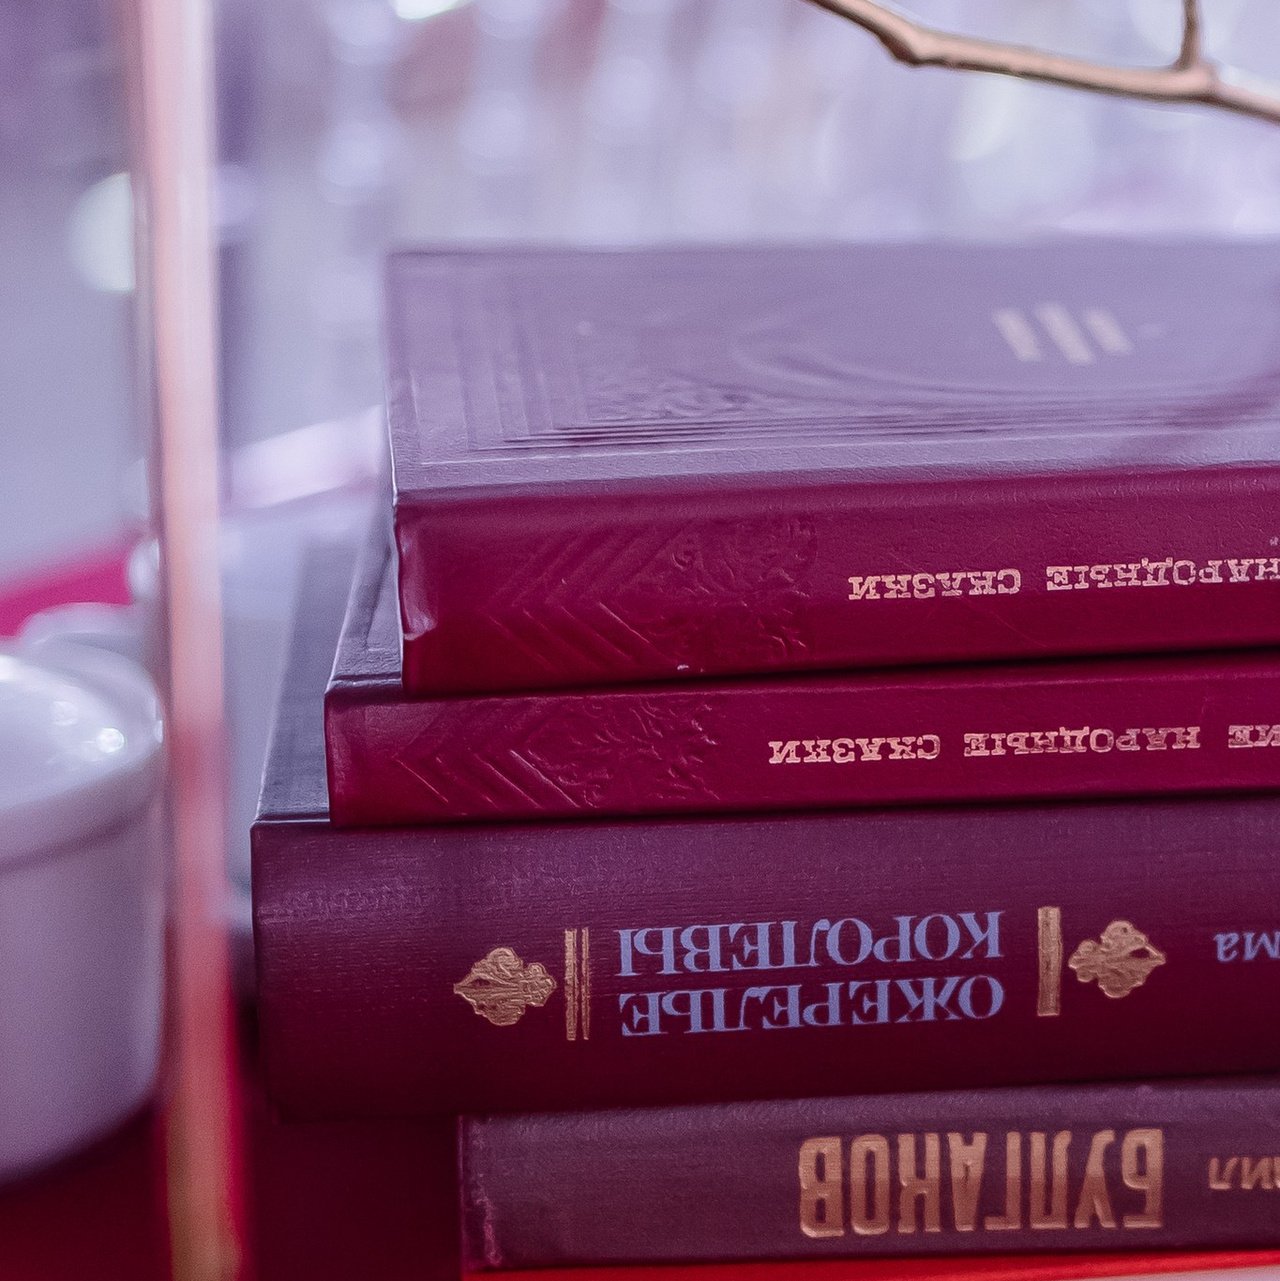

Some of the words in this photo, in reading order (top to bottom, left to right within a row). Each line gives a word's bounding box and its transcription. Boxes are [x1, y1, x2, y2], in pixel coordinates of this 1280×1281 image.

[848, 569, 1022, 600] СКАЗКИ
[768, 734, 941, 765] СКАЗКИ
[963, 725, 1201, 759] НАРОДНЫЕ
[613, 911, 1003, 977] КОРОЛЕВЫ
[620, 975, 1004, 1036] ОЖЕРЕЛЬЕ
[799, 1128, 1163, 1238] БУЛГАКОВ
